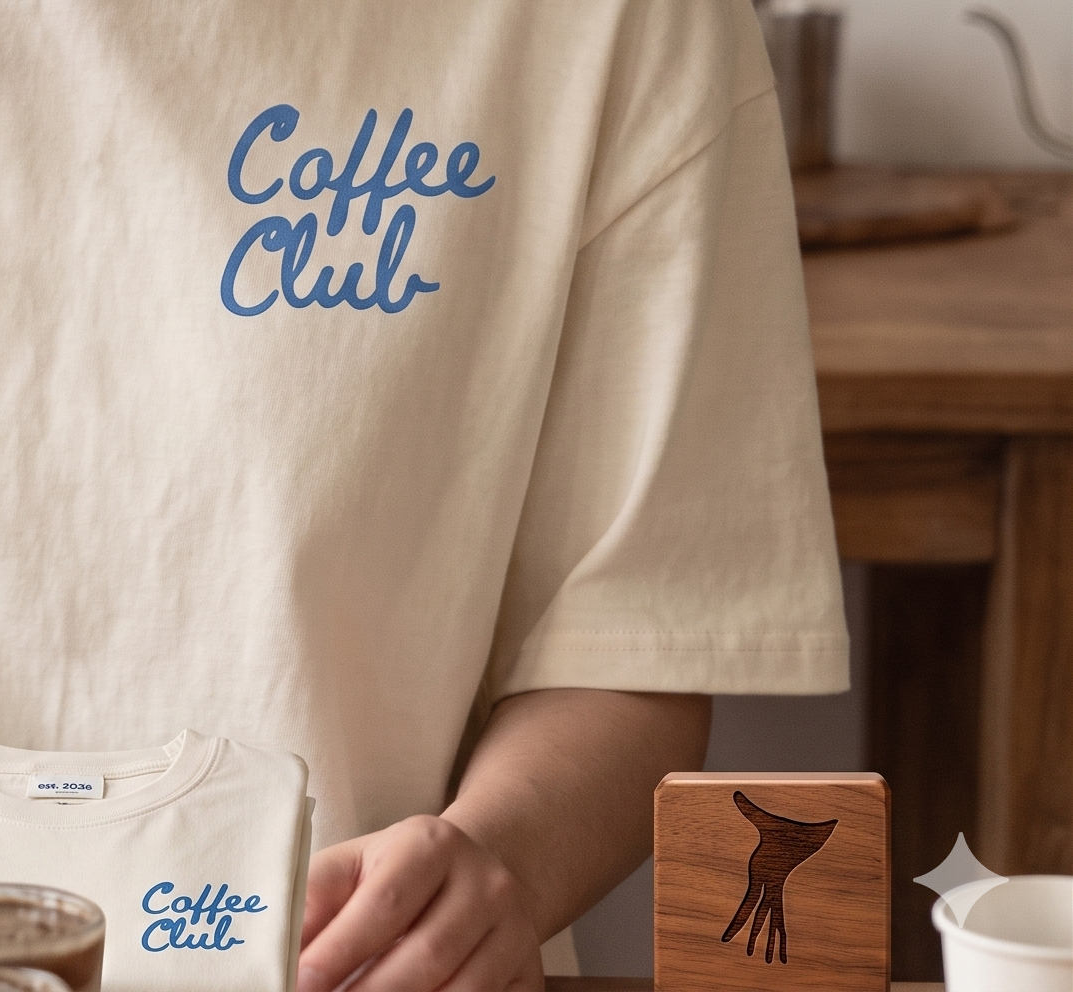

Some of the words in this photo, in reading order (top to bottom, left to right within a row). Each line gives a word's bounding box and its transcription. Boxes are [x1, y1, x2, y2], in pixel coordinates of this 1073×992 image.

[227, 103, 496, 236] Coffee
[220, 204, 440, 317] Club
[141, 881, 268, 925] Coffee
[141, 914, 245, 952] Club
